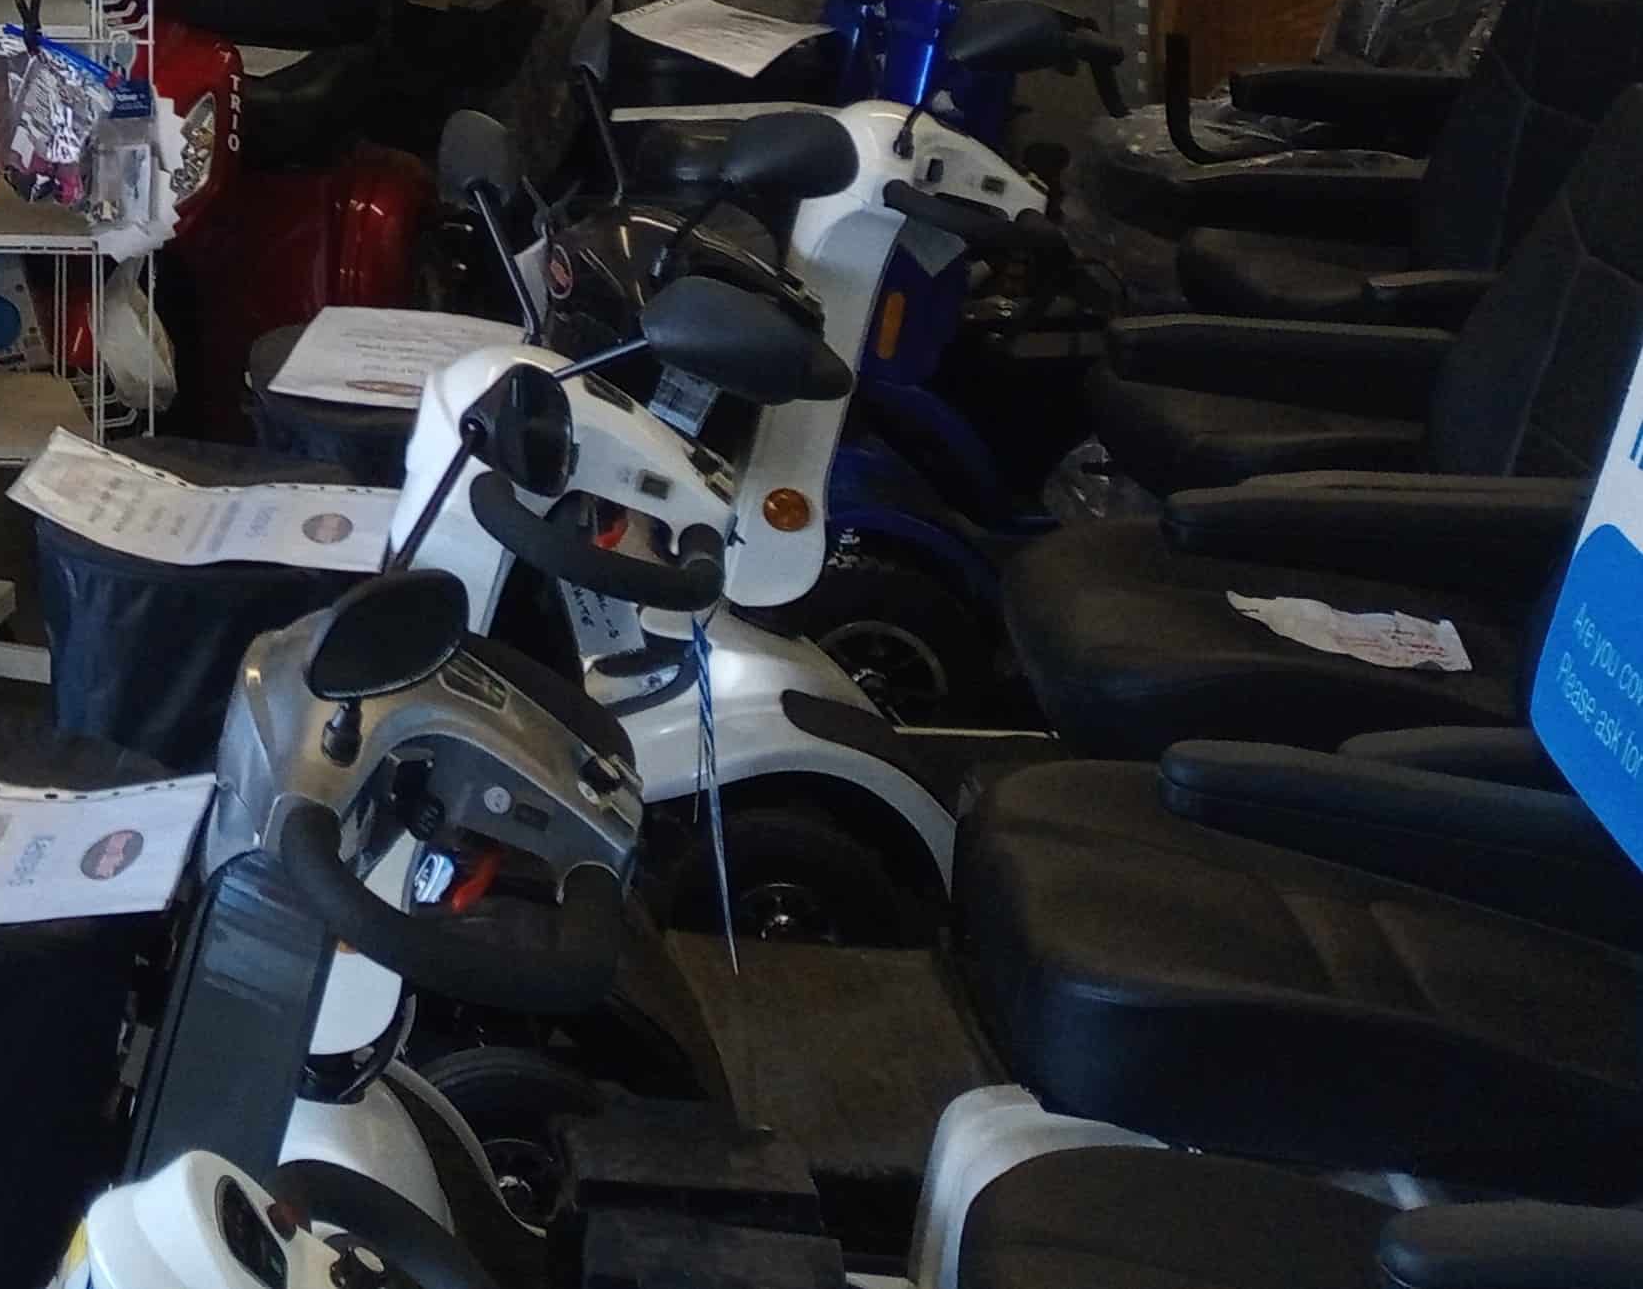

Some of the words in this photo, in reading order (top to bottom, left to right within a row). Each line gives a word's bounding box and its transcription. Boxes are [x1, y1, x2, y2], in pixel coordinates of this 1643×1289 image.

[227, 74, 242, 152] TRIO
[1573, 601, 1596, 649] Are
[1590, 632, 1621, 678] you
[1557, 650, 1597, 724] Please
[1594, 709, 1624, 756] ask
